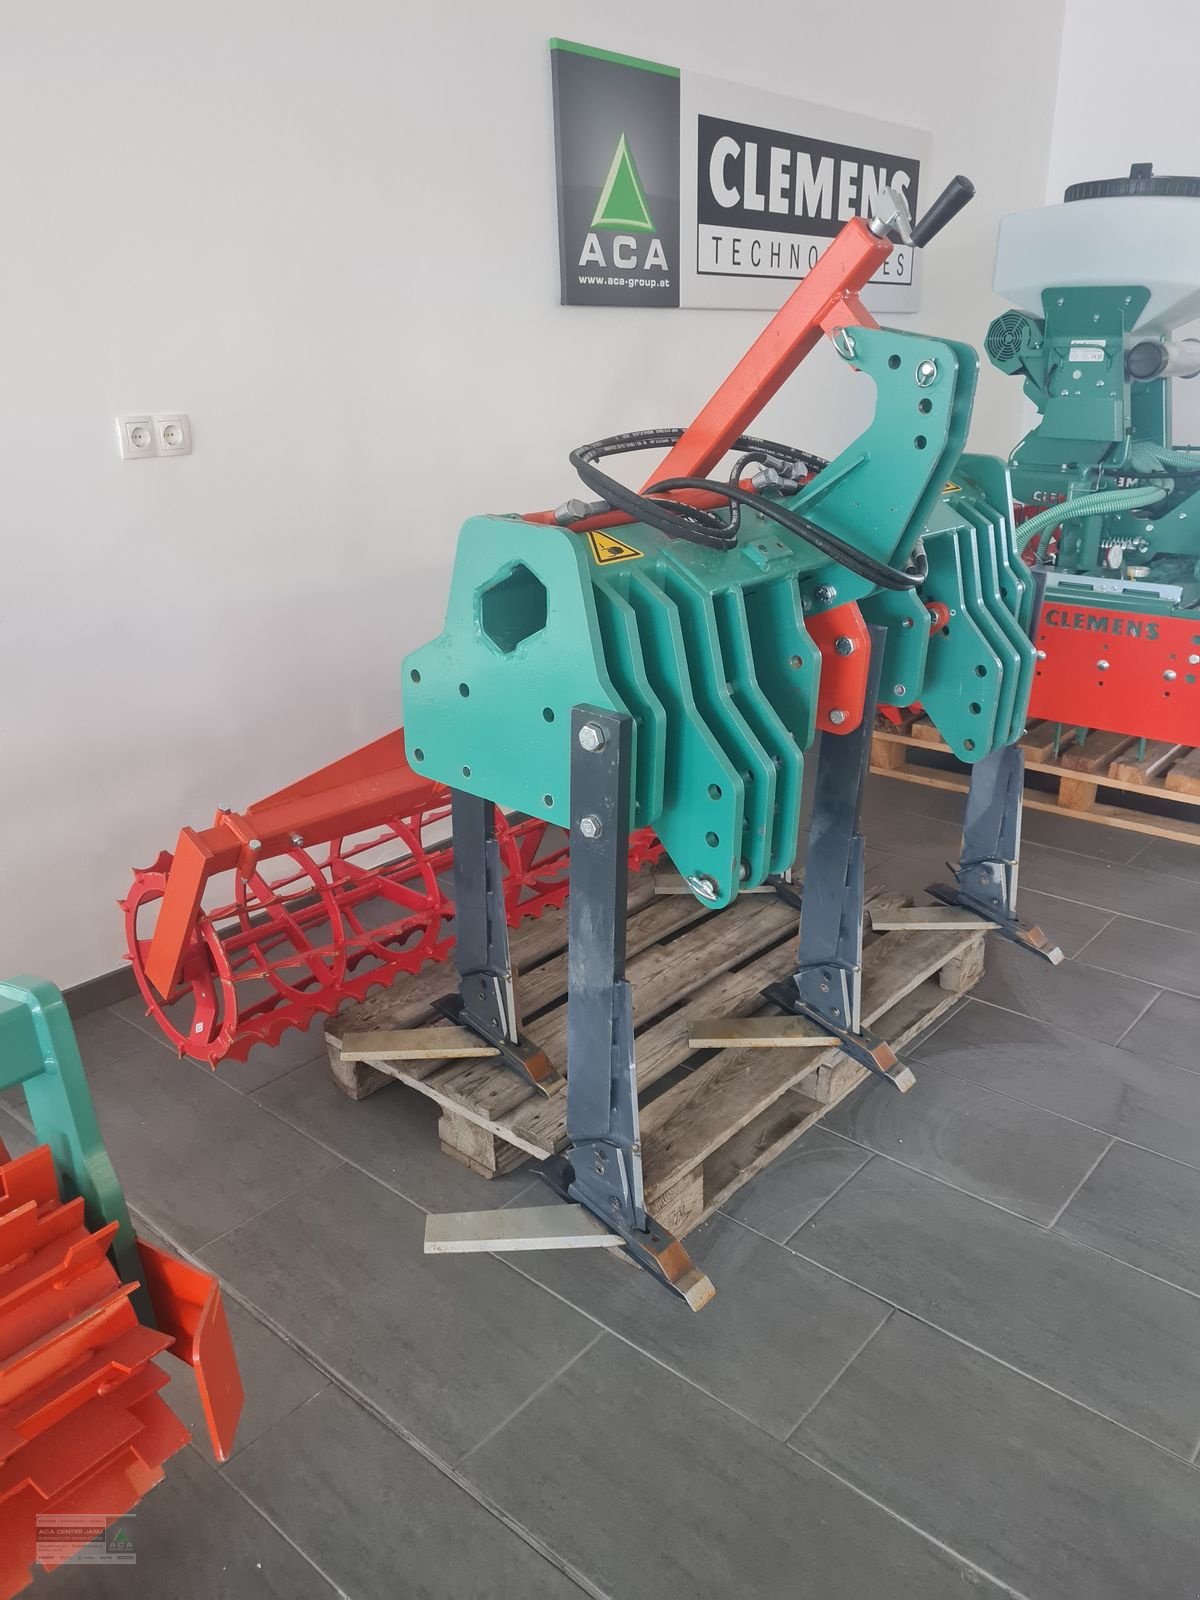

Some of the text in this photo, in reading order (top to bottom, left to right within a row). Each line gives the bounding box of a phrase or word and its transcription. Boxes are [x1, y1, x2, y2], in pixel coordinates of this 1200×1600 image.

[709, 136, 912, 223] CLEMENS
[579, 233, 669, 271] ACA
[712, 236, 905, 276] TECHNOES
[579, 276, 670, 288] www.aca-group.at
[1046, 609, 1159, 640] CLEMENS
